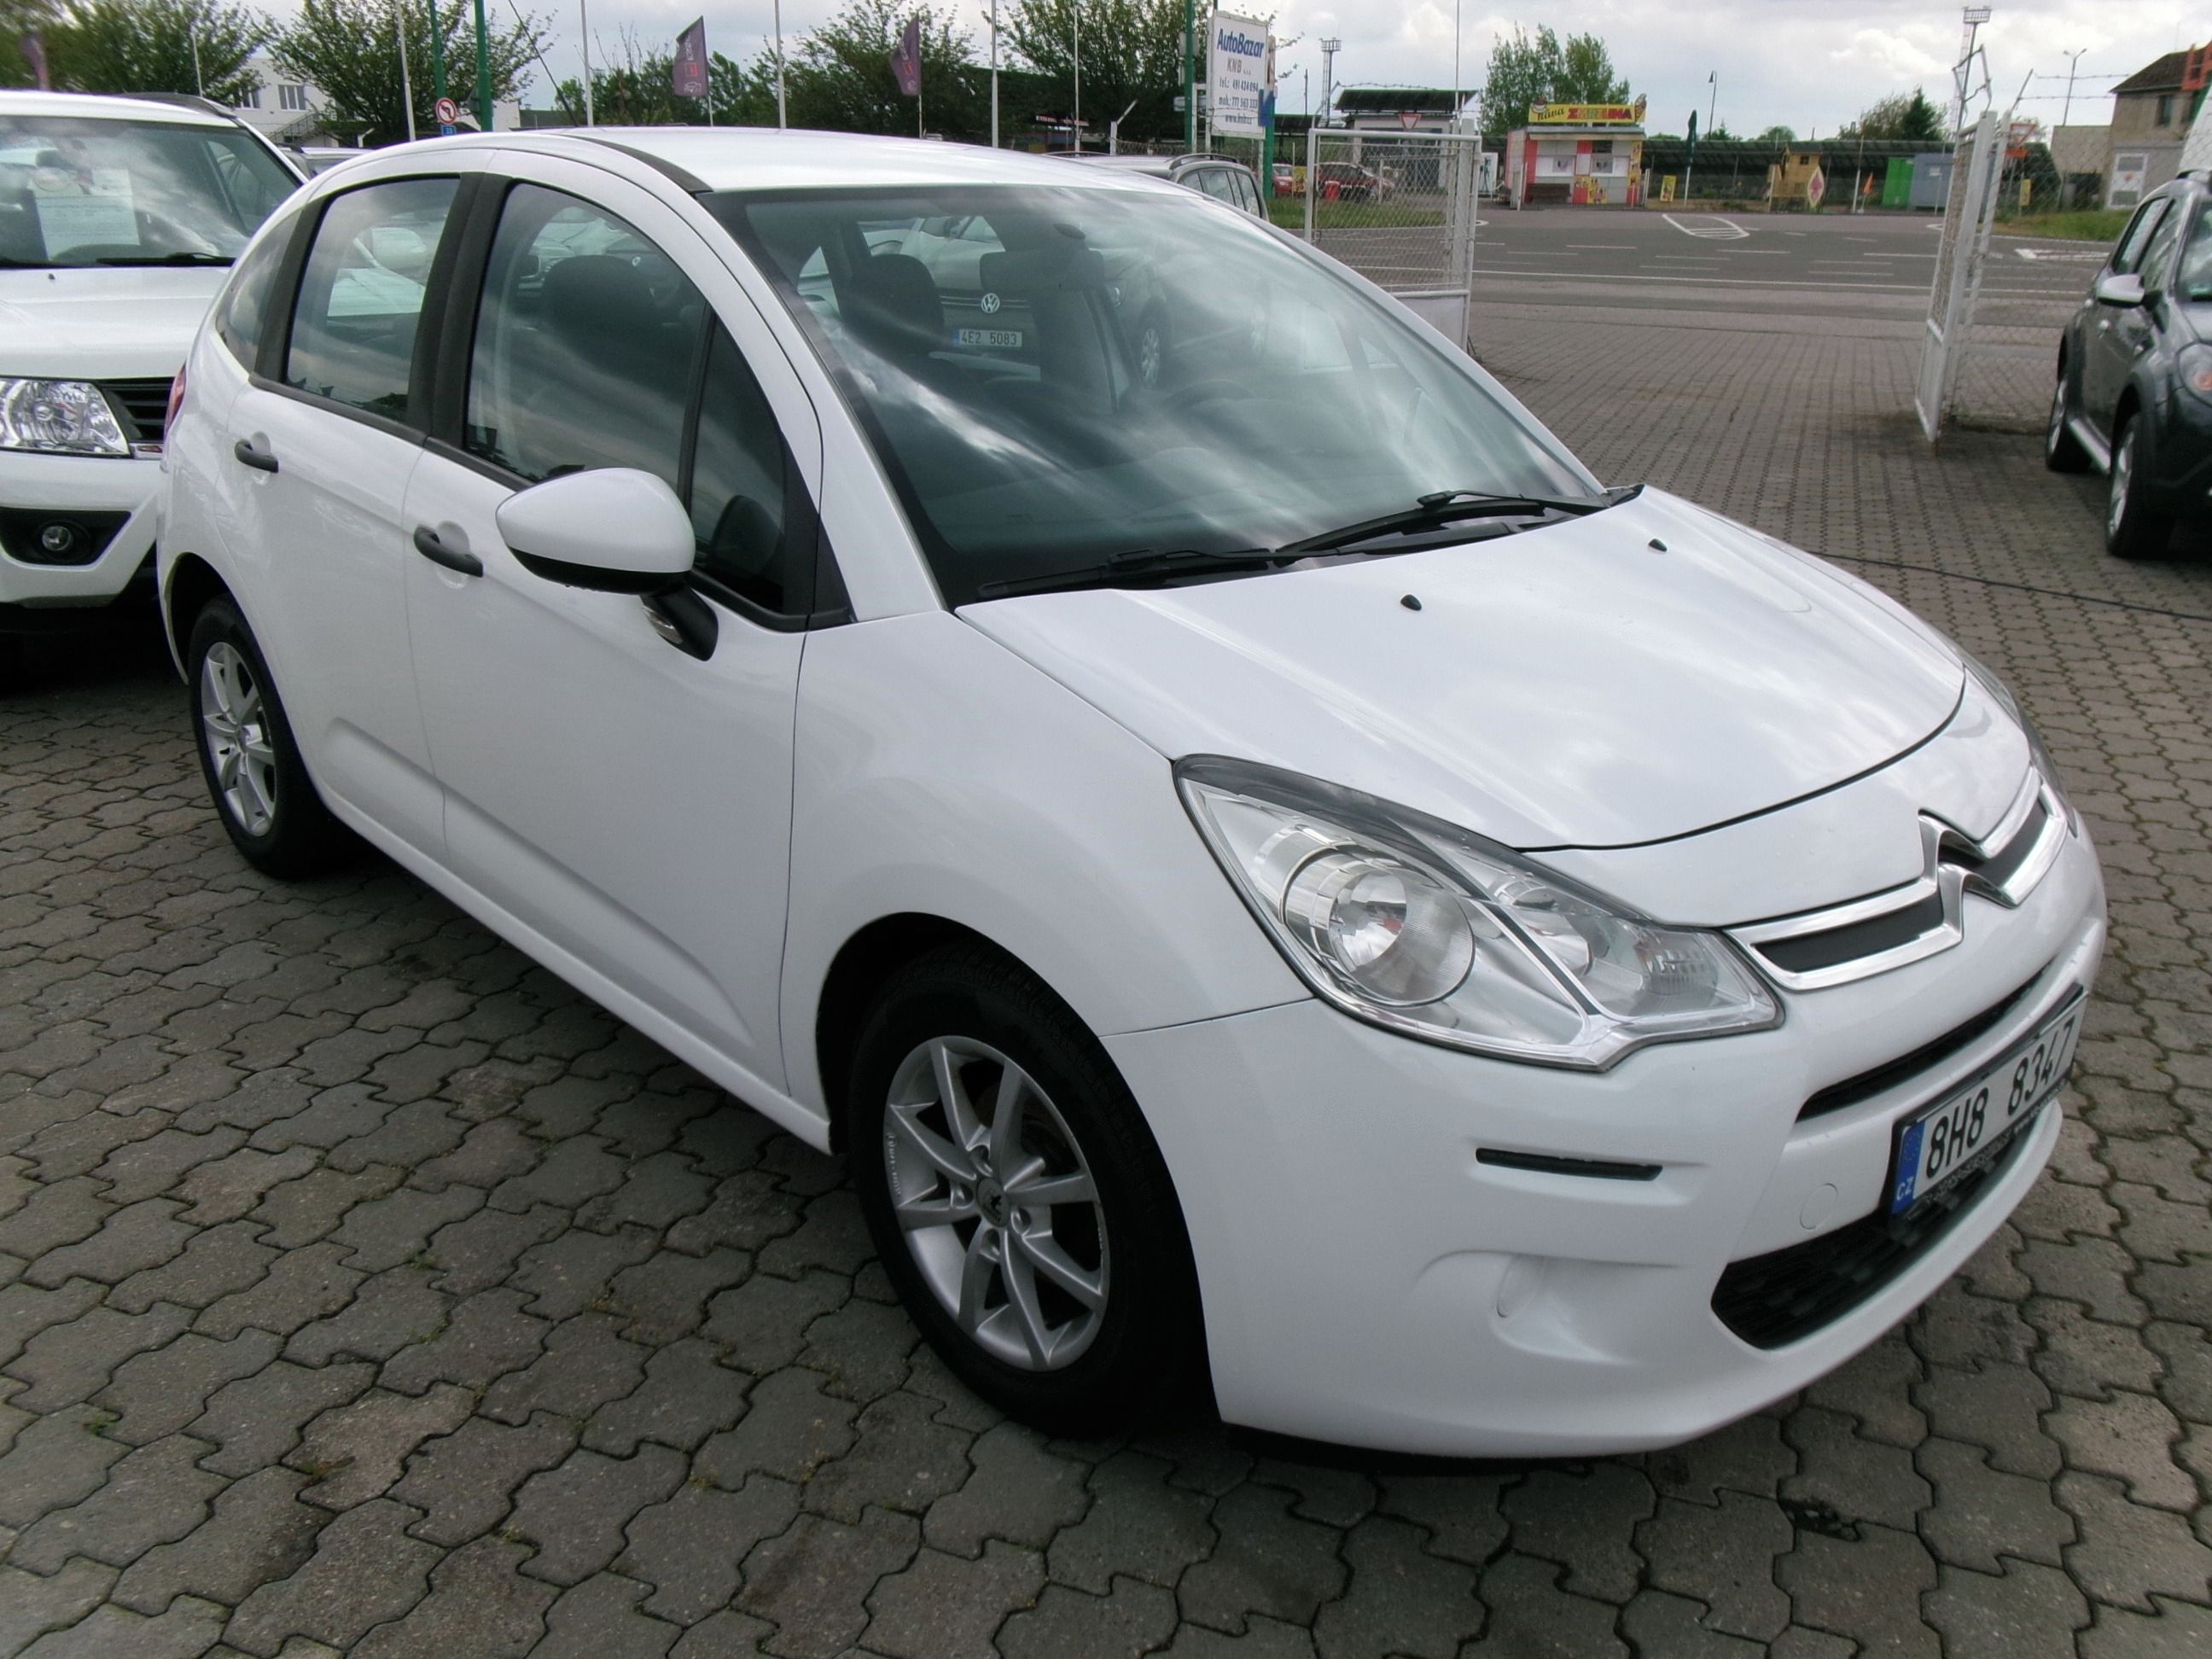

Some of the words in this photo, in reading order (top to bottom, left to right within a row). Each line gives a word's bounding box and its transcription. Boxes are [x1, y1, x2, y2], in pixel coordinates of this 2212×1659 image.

[1217, 27, 1265, 59] AutoBazar
[1227, 57, 1243, 73] KNB
[962, 329, 981, 344] 4E2
[990, 332, 1017, 346] 5083
[1926, 1086, 1989, 1179] 8H8
[2008, 1015, 2075, 1115] 8347
[1895, 1175, 1915, 1202] CZ
